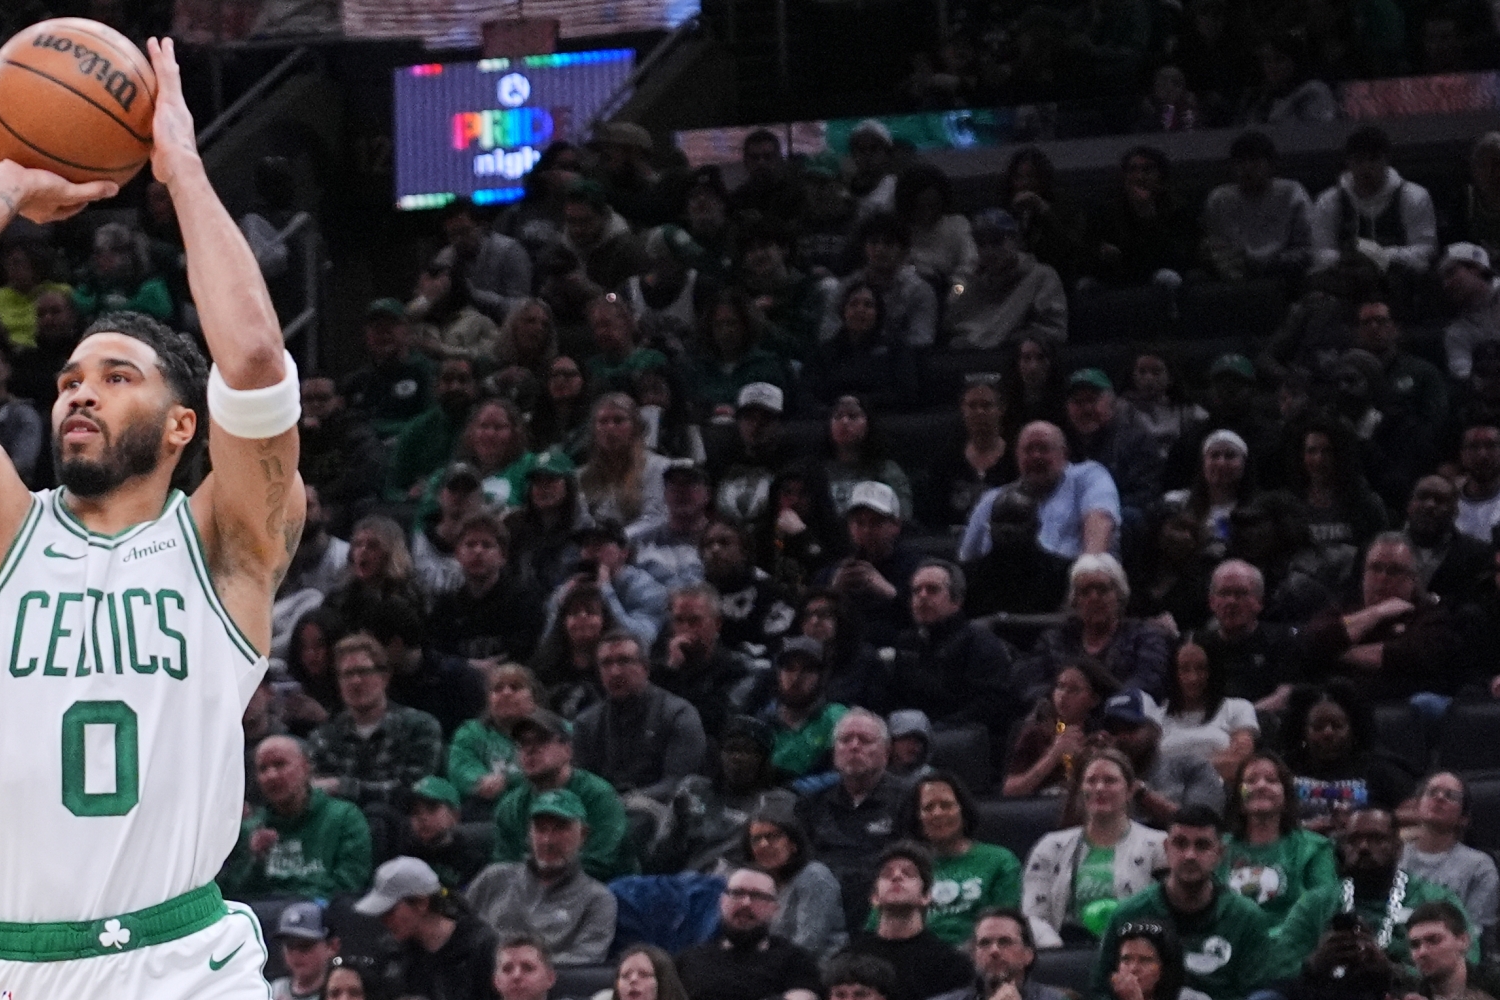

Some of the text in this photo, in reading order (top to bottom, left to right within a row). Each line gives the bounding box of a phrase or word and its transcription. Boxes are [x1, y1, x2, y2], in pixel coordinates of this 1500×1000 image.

[32, 33, 138, 112] Wilson
[453, 107, 572, 151] PRIDE
[122, 537, 178, 562] Amica
[61, 699, 140, 818] 0
